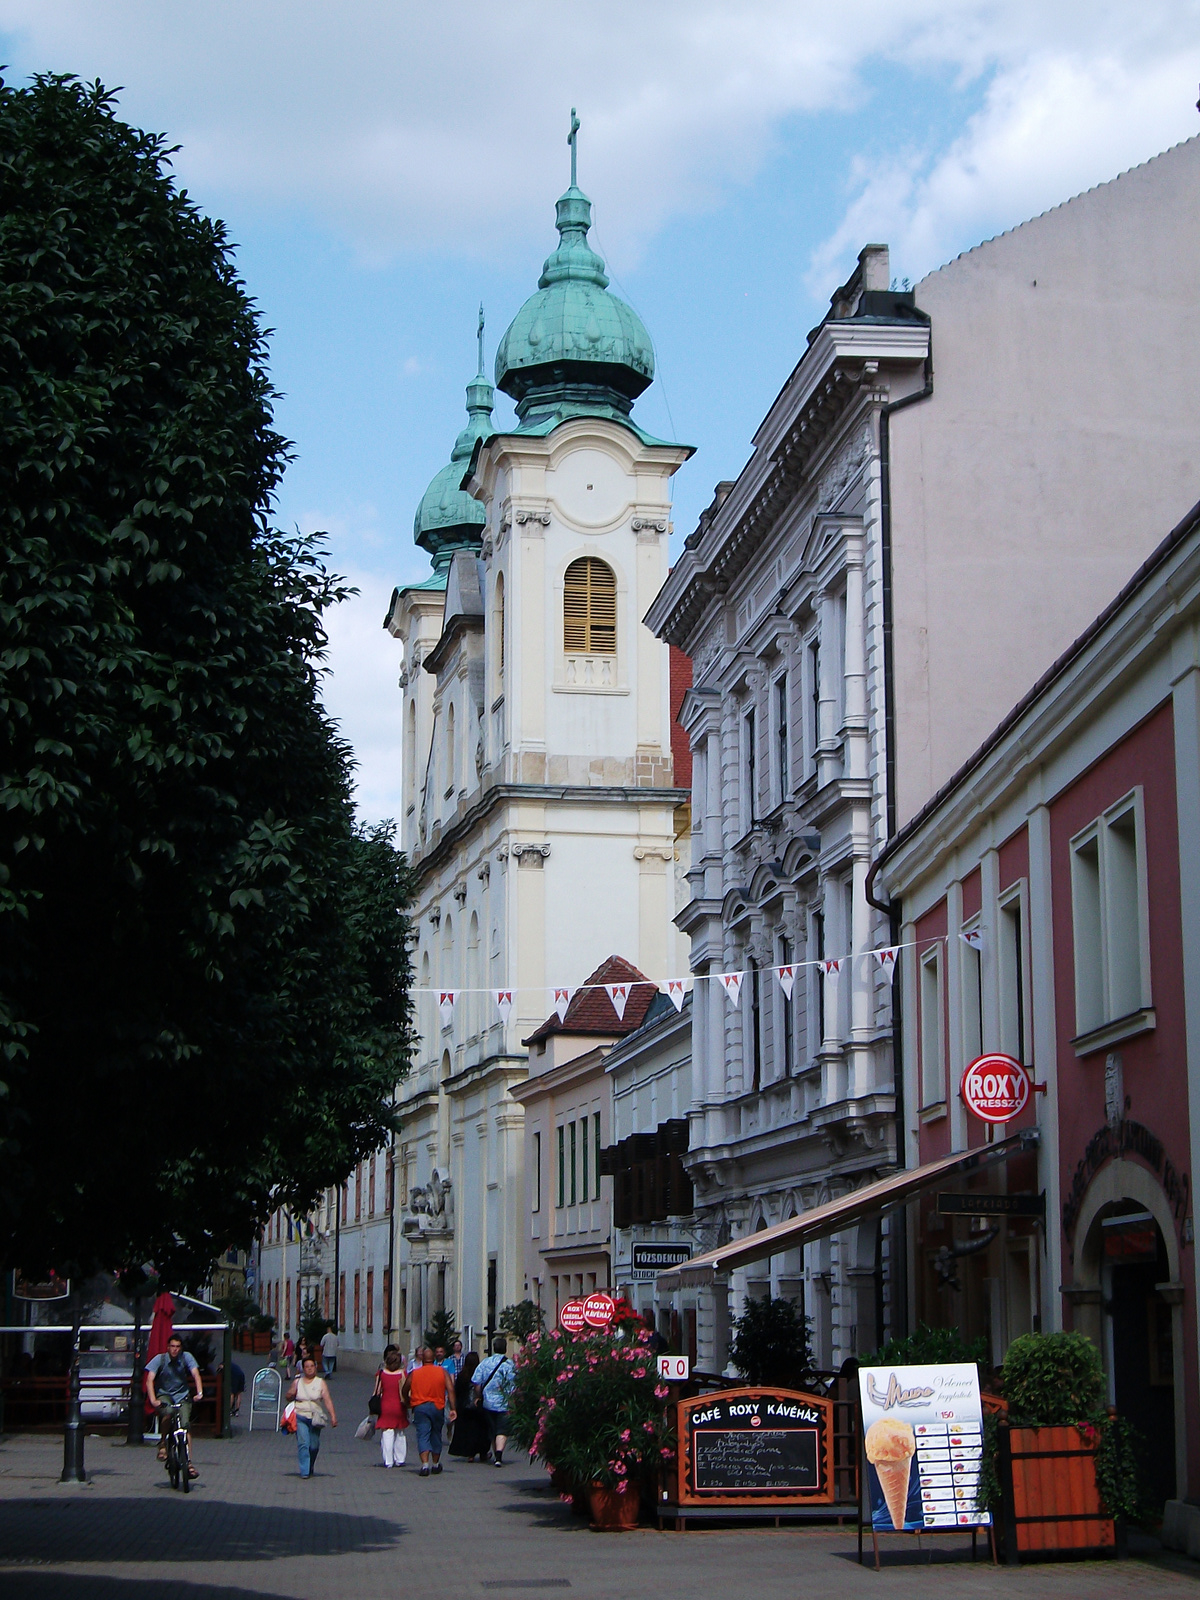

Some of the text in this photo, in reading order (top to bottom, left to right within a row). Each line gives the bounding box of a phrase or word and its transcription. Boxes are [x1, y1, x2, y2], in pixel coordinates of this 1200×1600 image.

[970, 1074, 1022, 1098] ROXY
[636, 1251, 688, 1263] TŐZSDEKLUB
[587, 1301, 611, 1310] ROXY
[661, 1360, 670, 1376] R
[692, 1403, 819, 1424] CAFÉ ROXY KÁVÉHÁZ
[941, 1410, 954, 1419] 150
